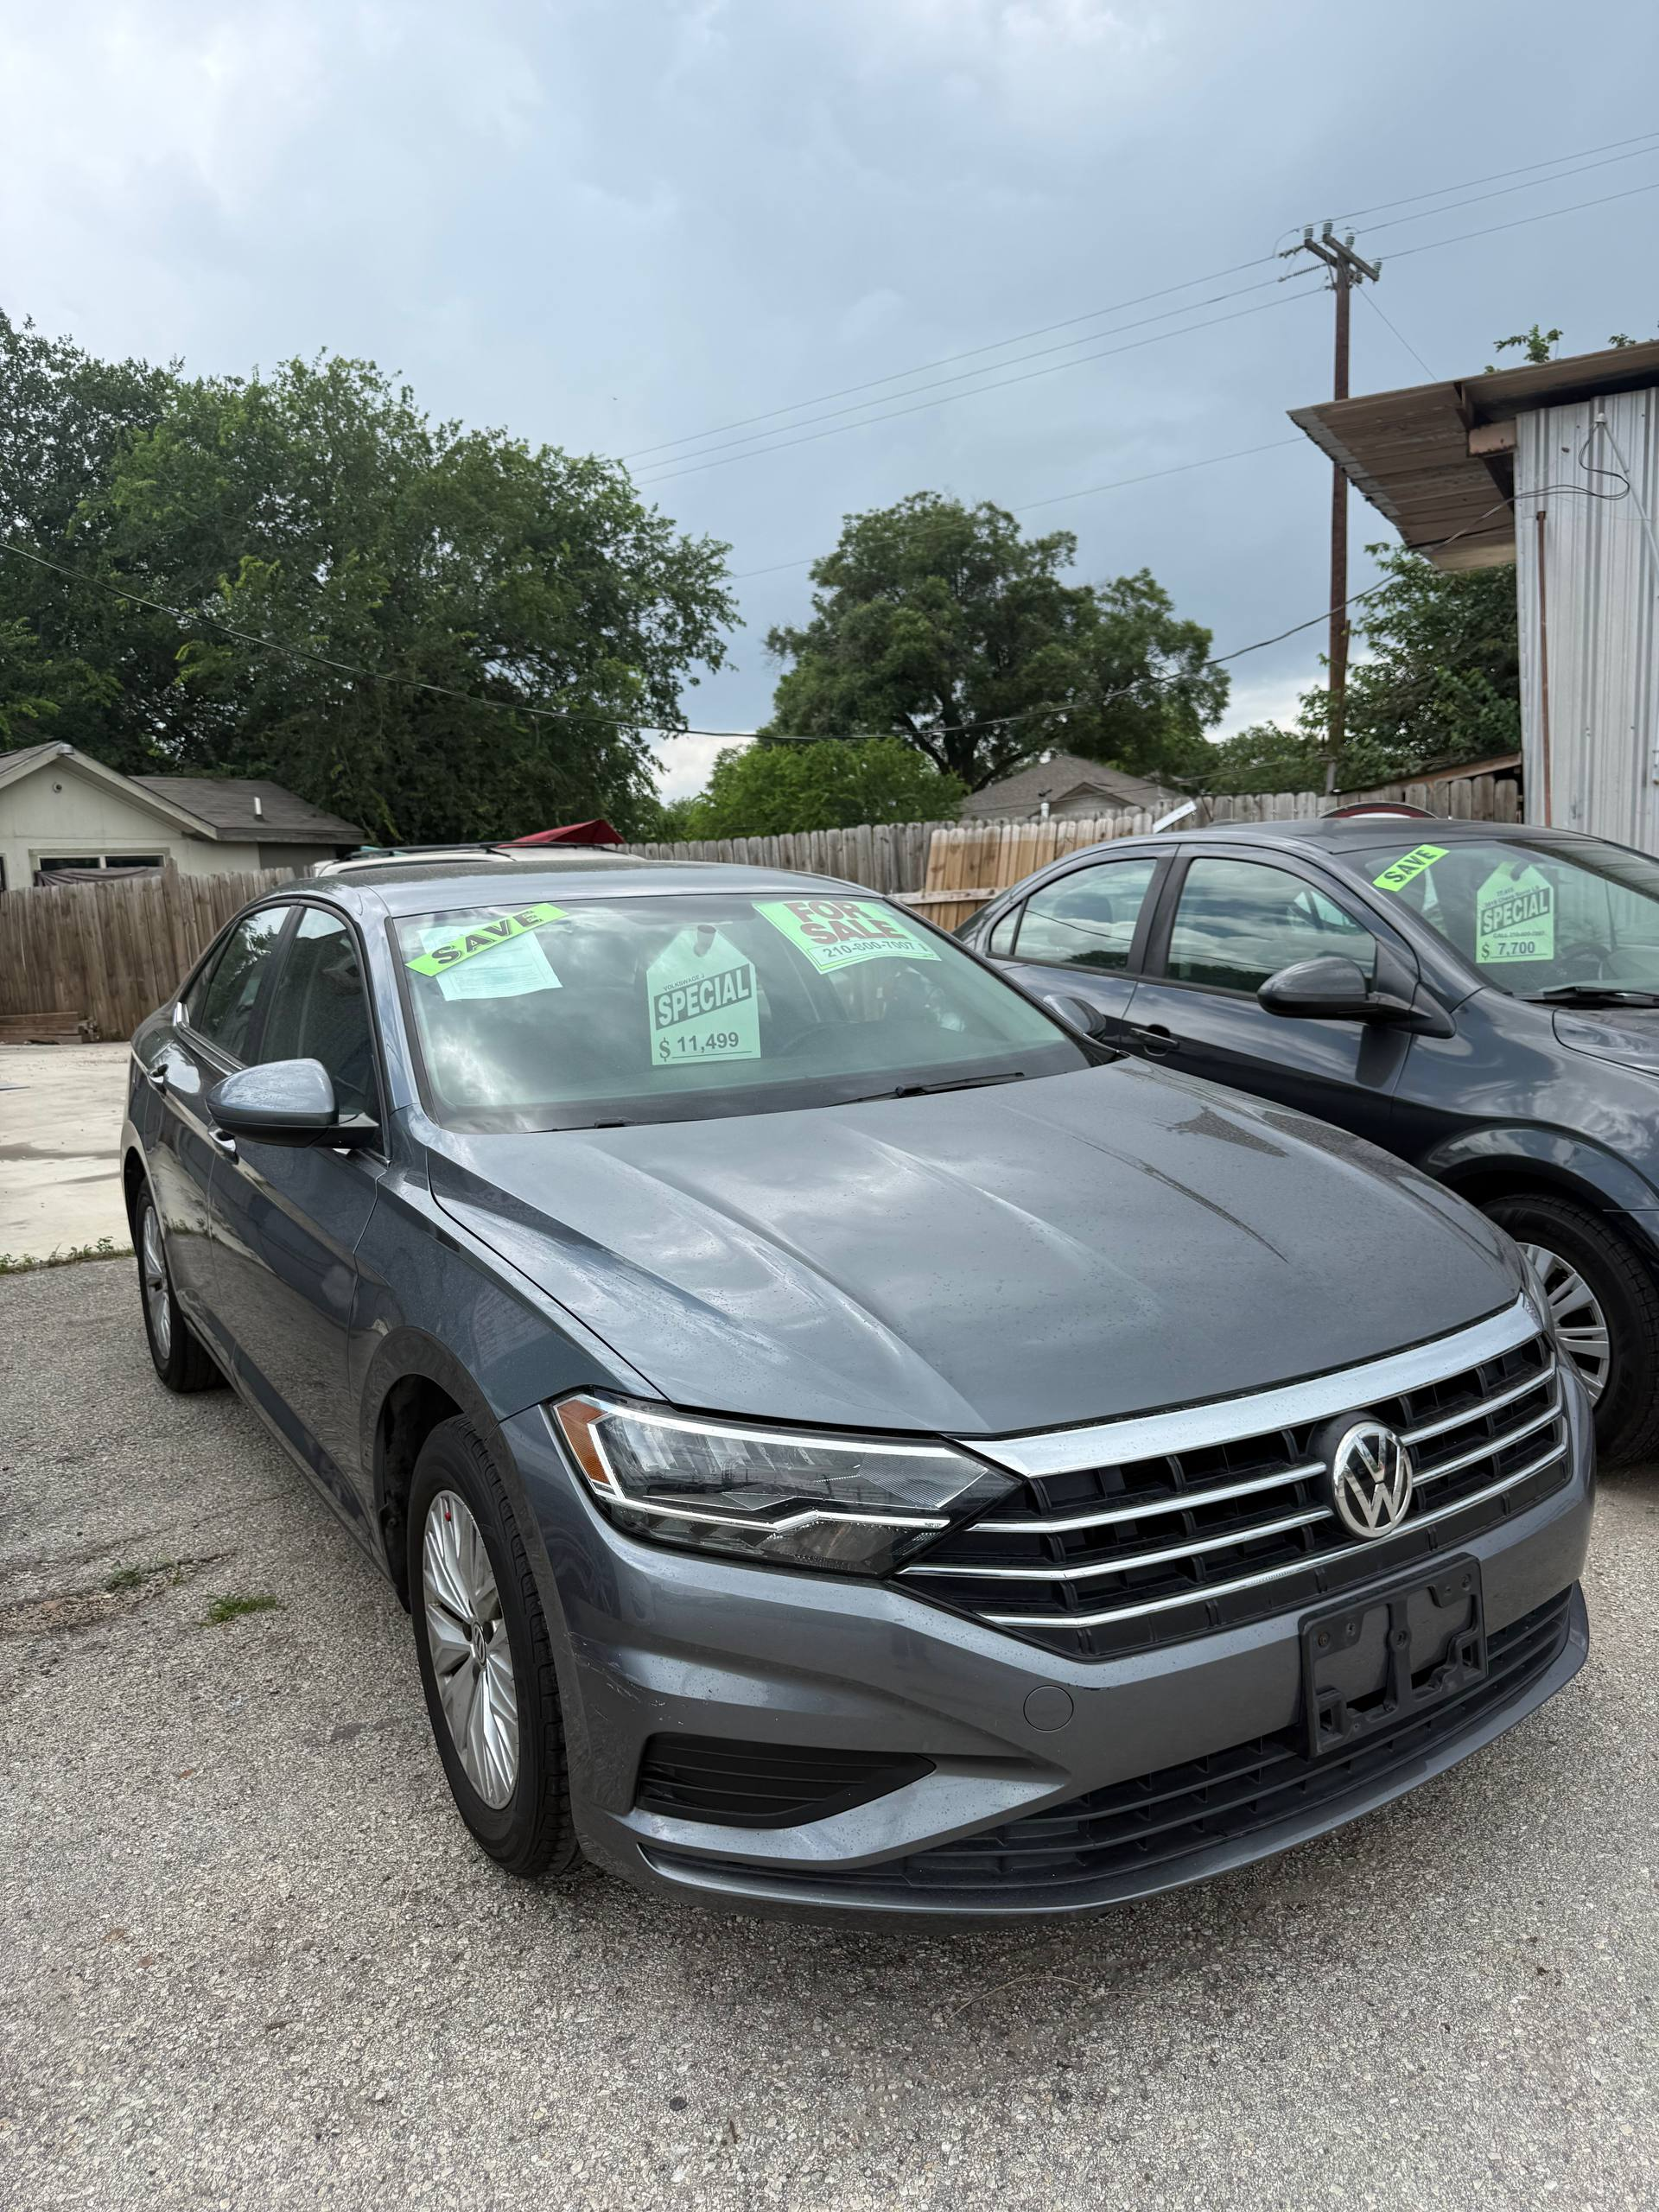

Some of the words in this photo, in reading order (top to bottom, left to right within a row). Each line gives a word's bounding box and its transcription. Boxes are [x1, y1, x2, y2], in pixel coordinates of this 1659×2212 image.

[1384, 849, 1438, 883] SAVE
[783, 901, 874, 922] FOR
[1483, 891, 1548, 933] SPECIAL
[431, 911, 543, 964] SAVE
[800, 919, 909, 944] SALE
[1481, 942, 1491, 961] $
[1497, 941, 1535, 957] 7,700
[658, 969, 750, 1027] SPECIAL
[659, 1037, 671, 1063] $
[677, 1032, 740, 1053] 11,499
